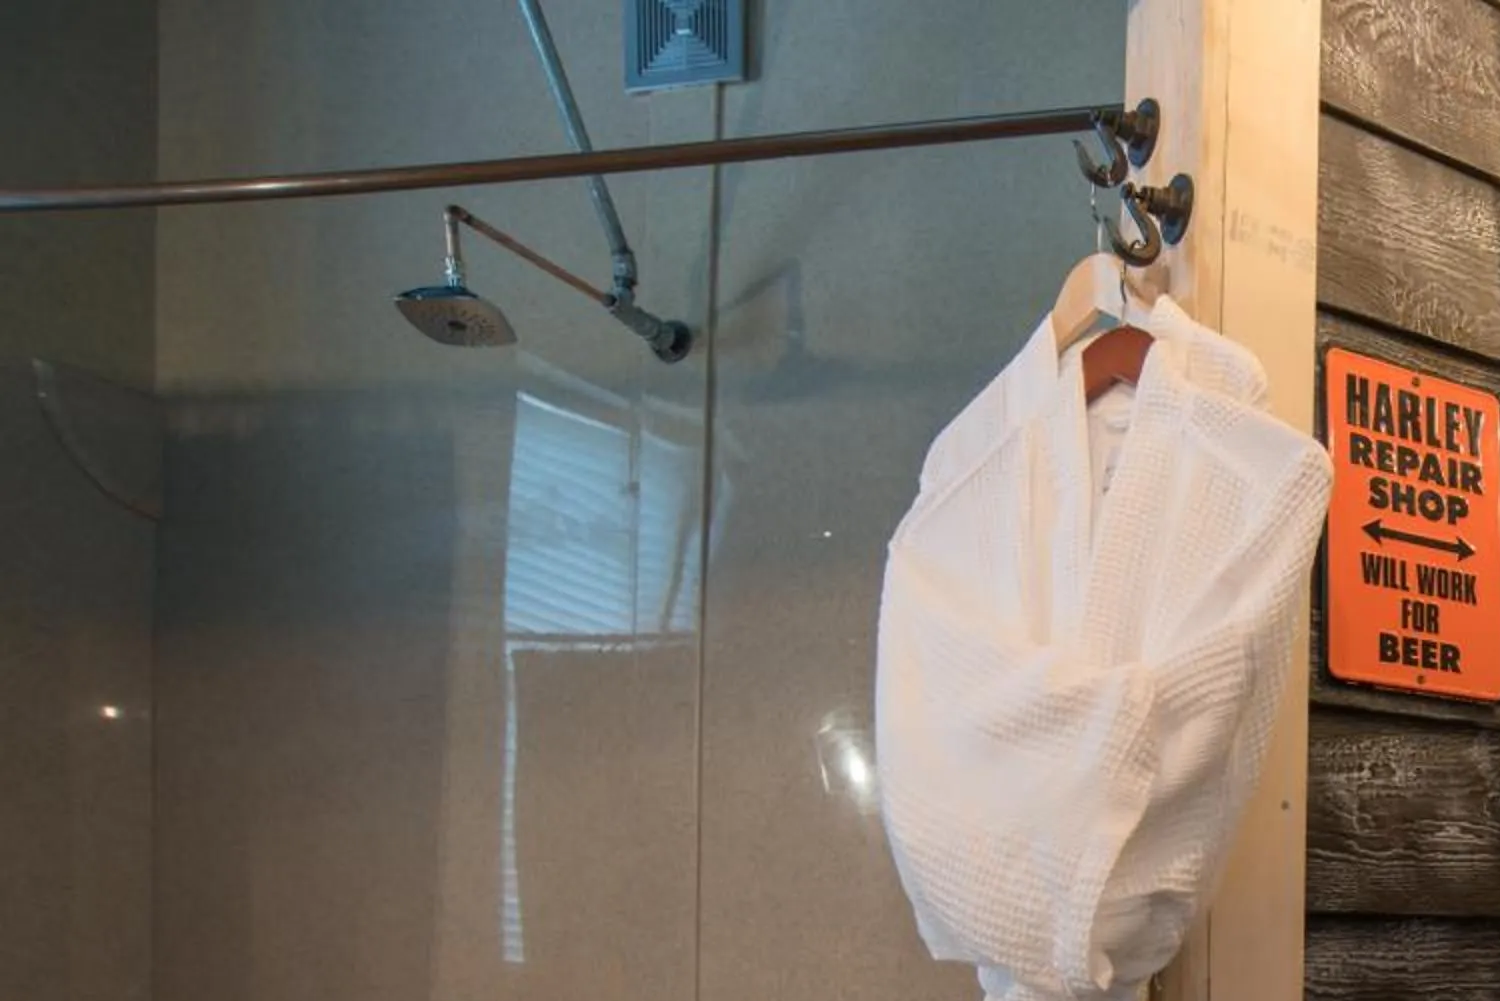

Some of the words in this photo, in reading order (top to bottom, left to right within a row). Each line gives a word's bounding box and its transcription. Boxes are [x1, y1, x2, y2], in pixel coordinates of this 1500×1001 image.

[1346, 373, 1483, 457] HARLEY
[1349, 432, 1483, 496] REPAIR
[1368, 476, 1469, 525] SHOP
[1361, 551, 1409, 592] WILL
[1416, 563, 1477, 605] WORK
[1401, 598, 1440, 634] FOR
[1379, 631, 1461, 673] BEER
